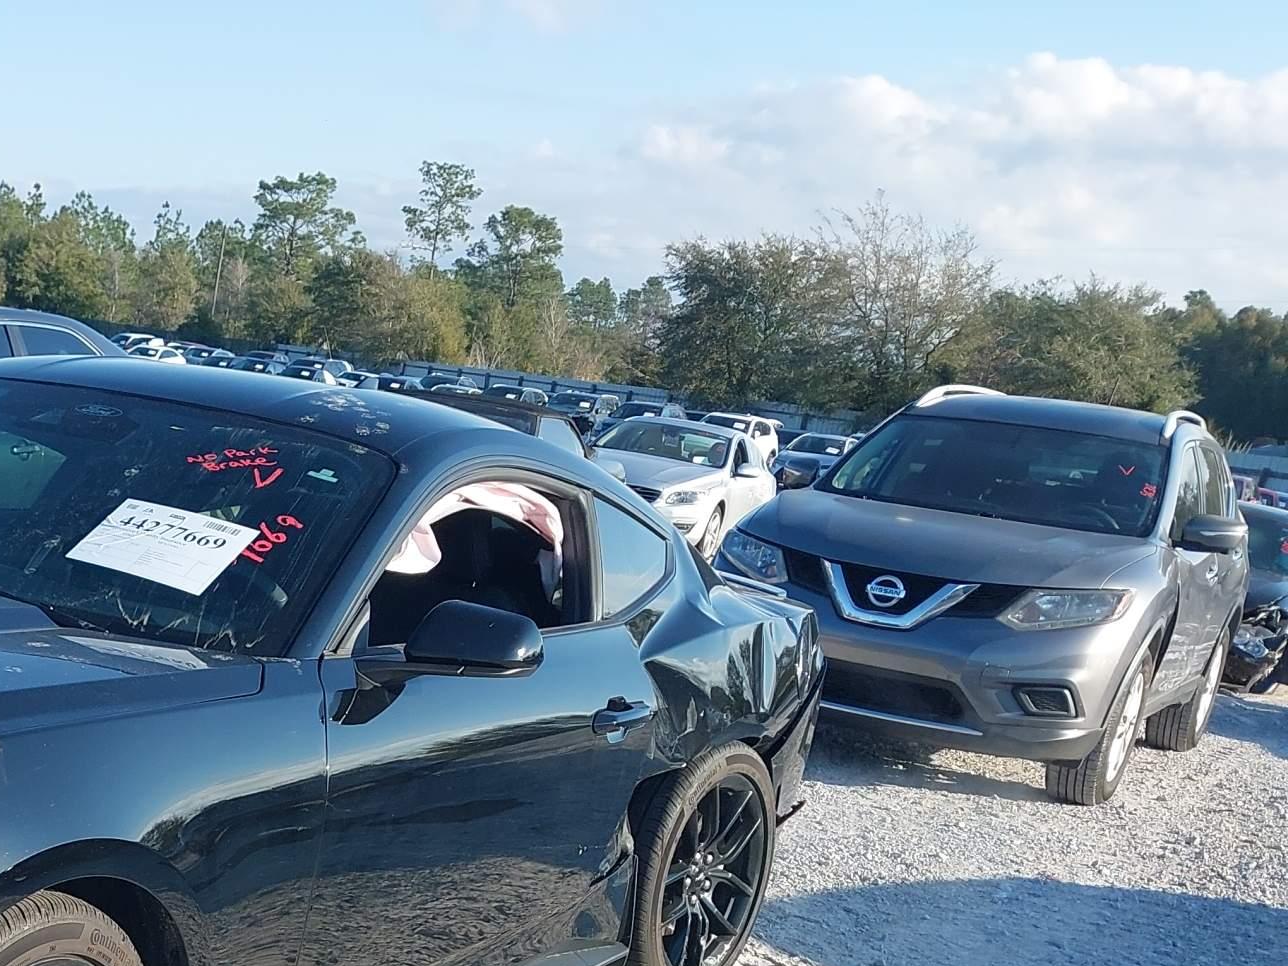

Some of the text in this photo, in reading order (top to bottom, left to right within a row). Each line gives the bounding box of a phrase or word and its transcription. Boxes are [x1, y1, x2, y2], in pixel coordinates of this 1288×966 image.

[224, 447, 279, 458] Park
[202, 457, 278, 472] Brake
[119, 515, 227, 550] 44277669
[869, 585, 902, 597] NISSAN
